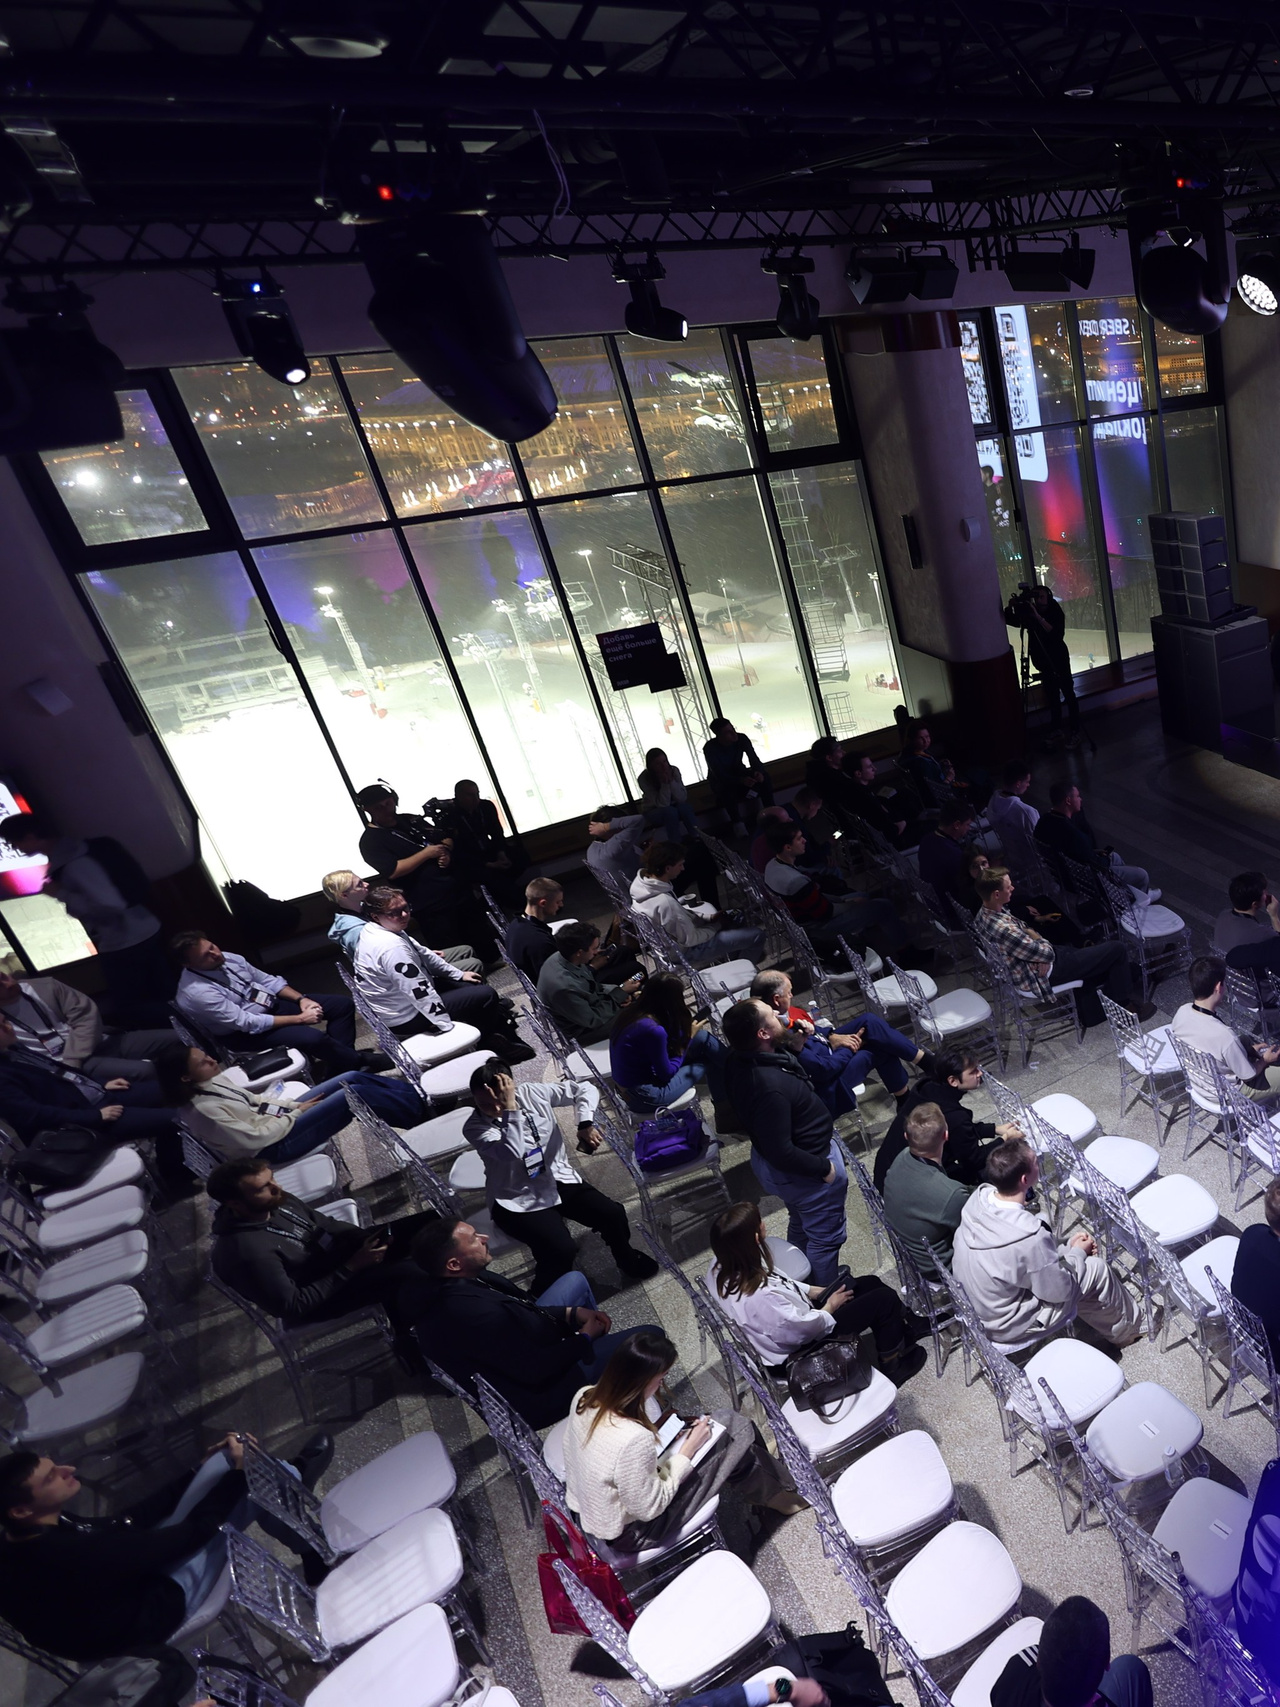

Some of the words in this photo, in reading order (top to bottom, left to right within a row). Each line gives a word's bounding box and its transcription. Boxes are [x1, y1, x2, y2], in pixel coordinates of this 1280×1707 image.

[603, 633, 635, 645] Добавь
[606, 644, 623, 653] ещё
[625, 638, 657, 649] больше
[609, 653, 632, 662] снега
